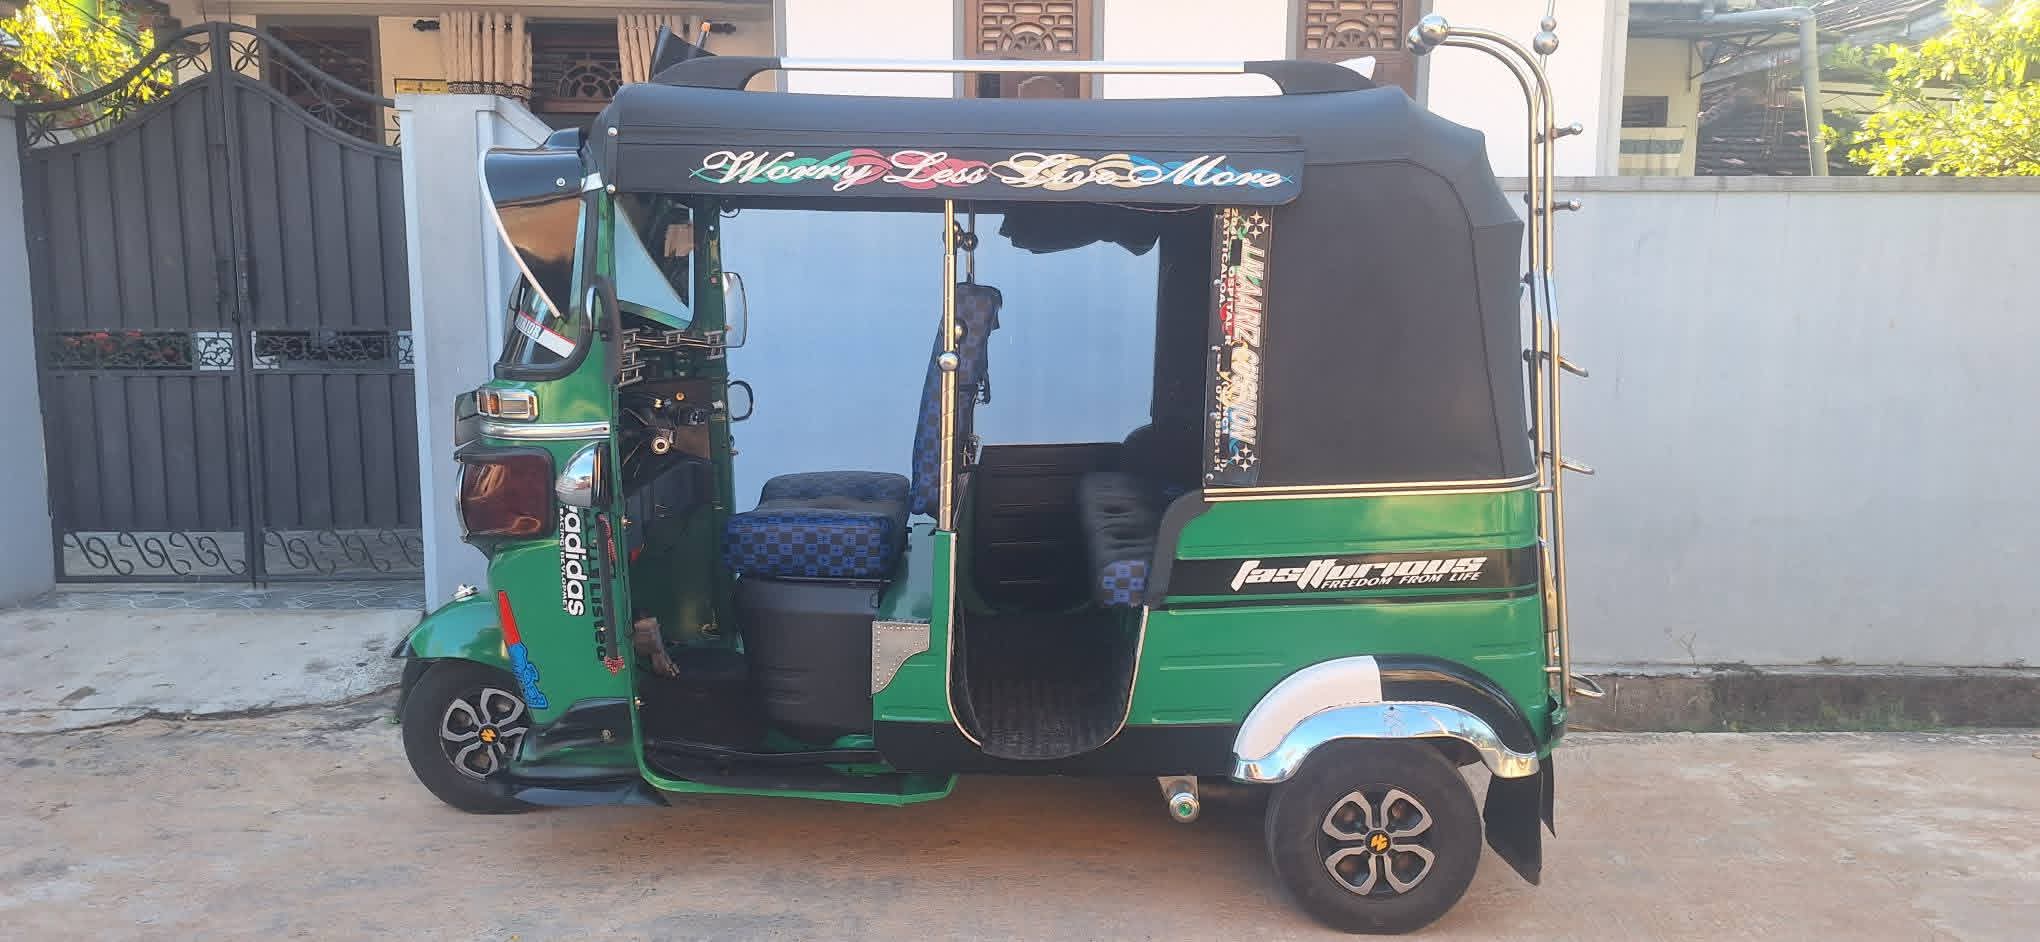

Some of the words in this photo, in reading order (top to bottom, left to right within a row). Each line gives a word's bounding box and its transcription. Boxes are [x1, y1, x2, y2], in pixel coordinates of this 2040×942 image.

[703, 151, 873, 191] Worry
[883, 150, 988, 184] Less
[1127, 154, 1282, 187] More
[564, 512, 588, 616] adidas
[1320, 575, 1393, 590] FREEDOM
[1399, 573, 1444, 585] FROM
[1449, 571, 1484, 582] LIFE
